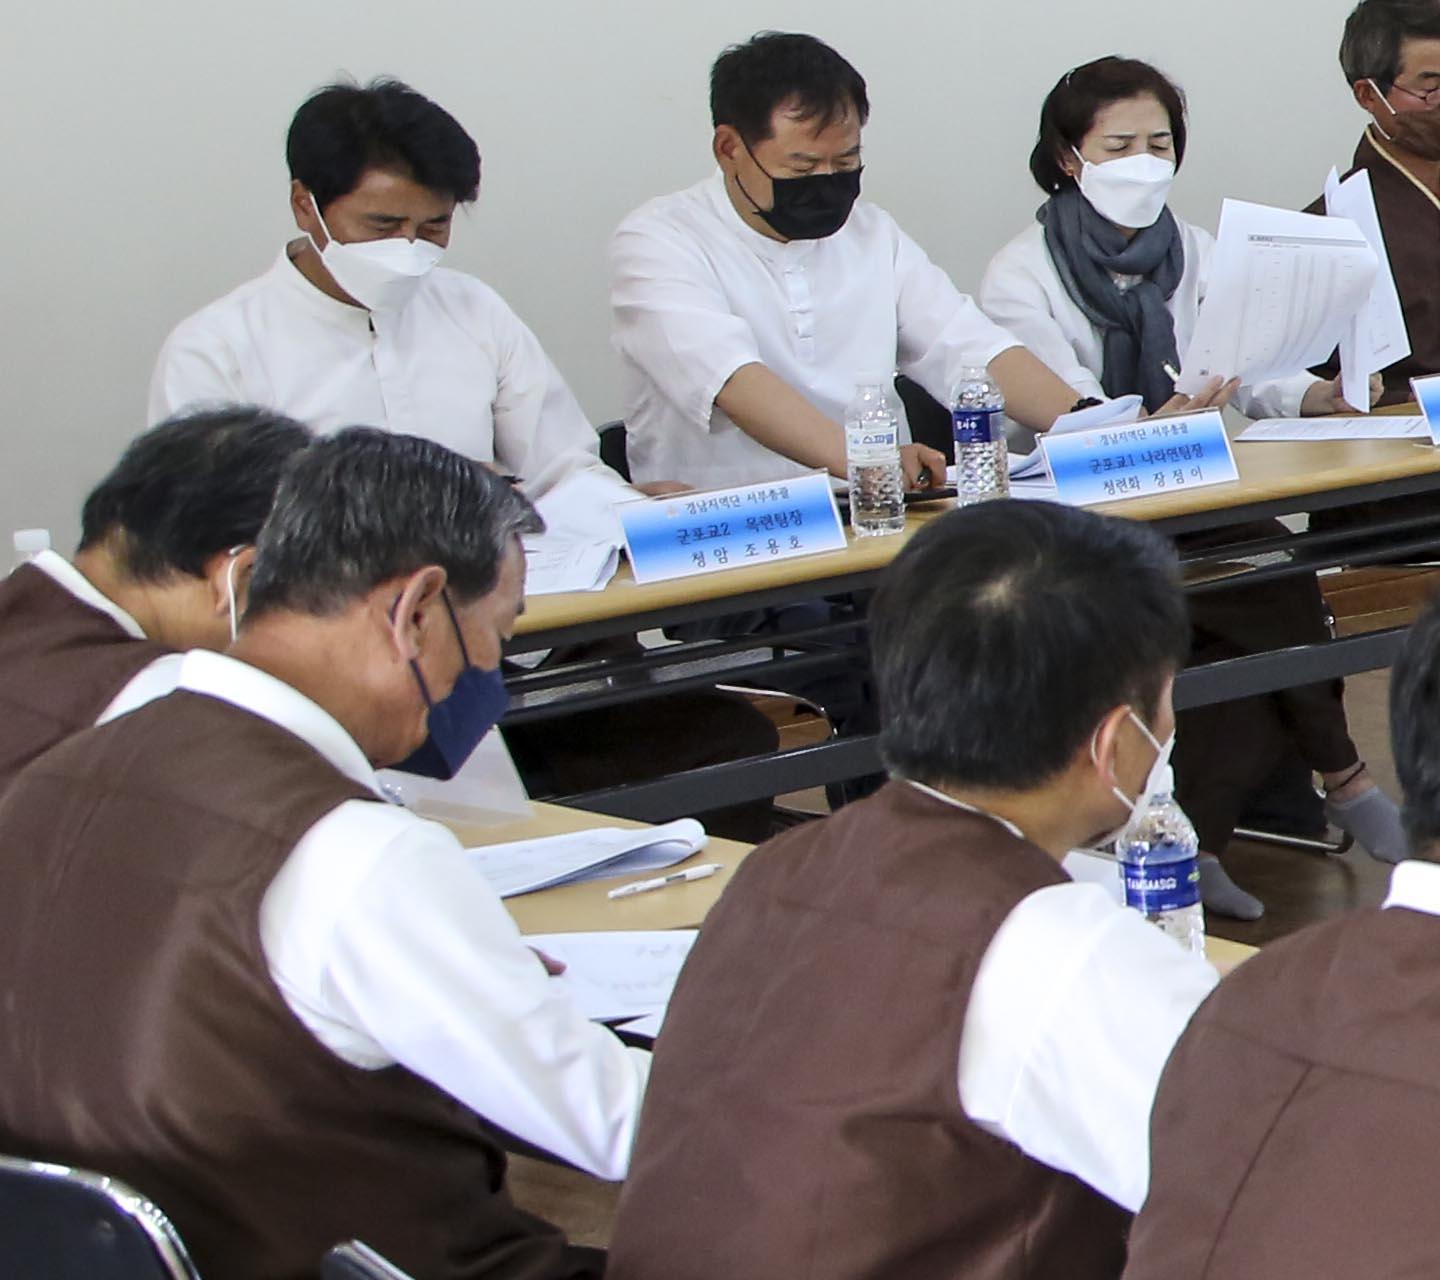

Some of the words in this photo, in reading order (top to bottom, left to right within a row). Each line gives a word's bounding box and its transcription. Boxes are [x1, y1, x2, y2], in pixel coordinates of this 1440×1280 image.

[1099, 428, 1148, 447] 경남지역단
[685, 495, 741, 515] 경남지역단
[747, 486, 789, 504] 서부총괄
